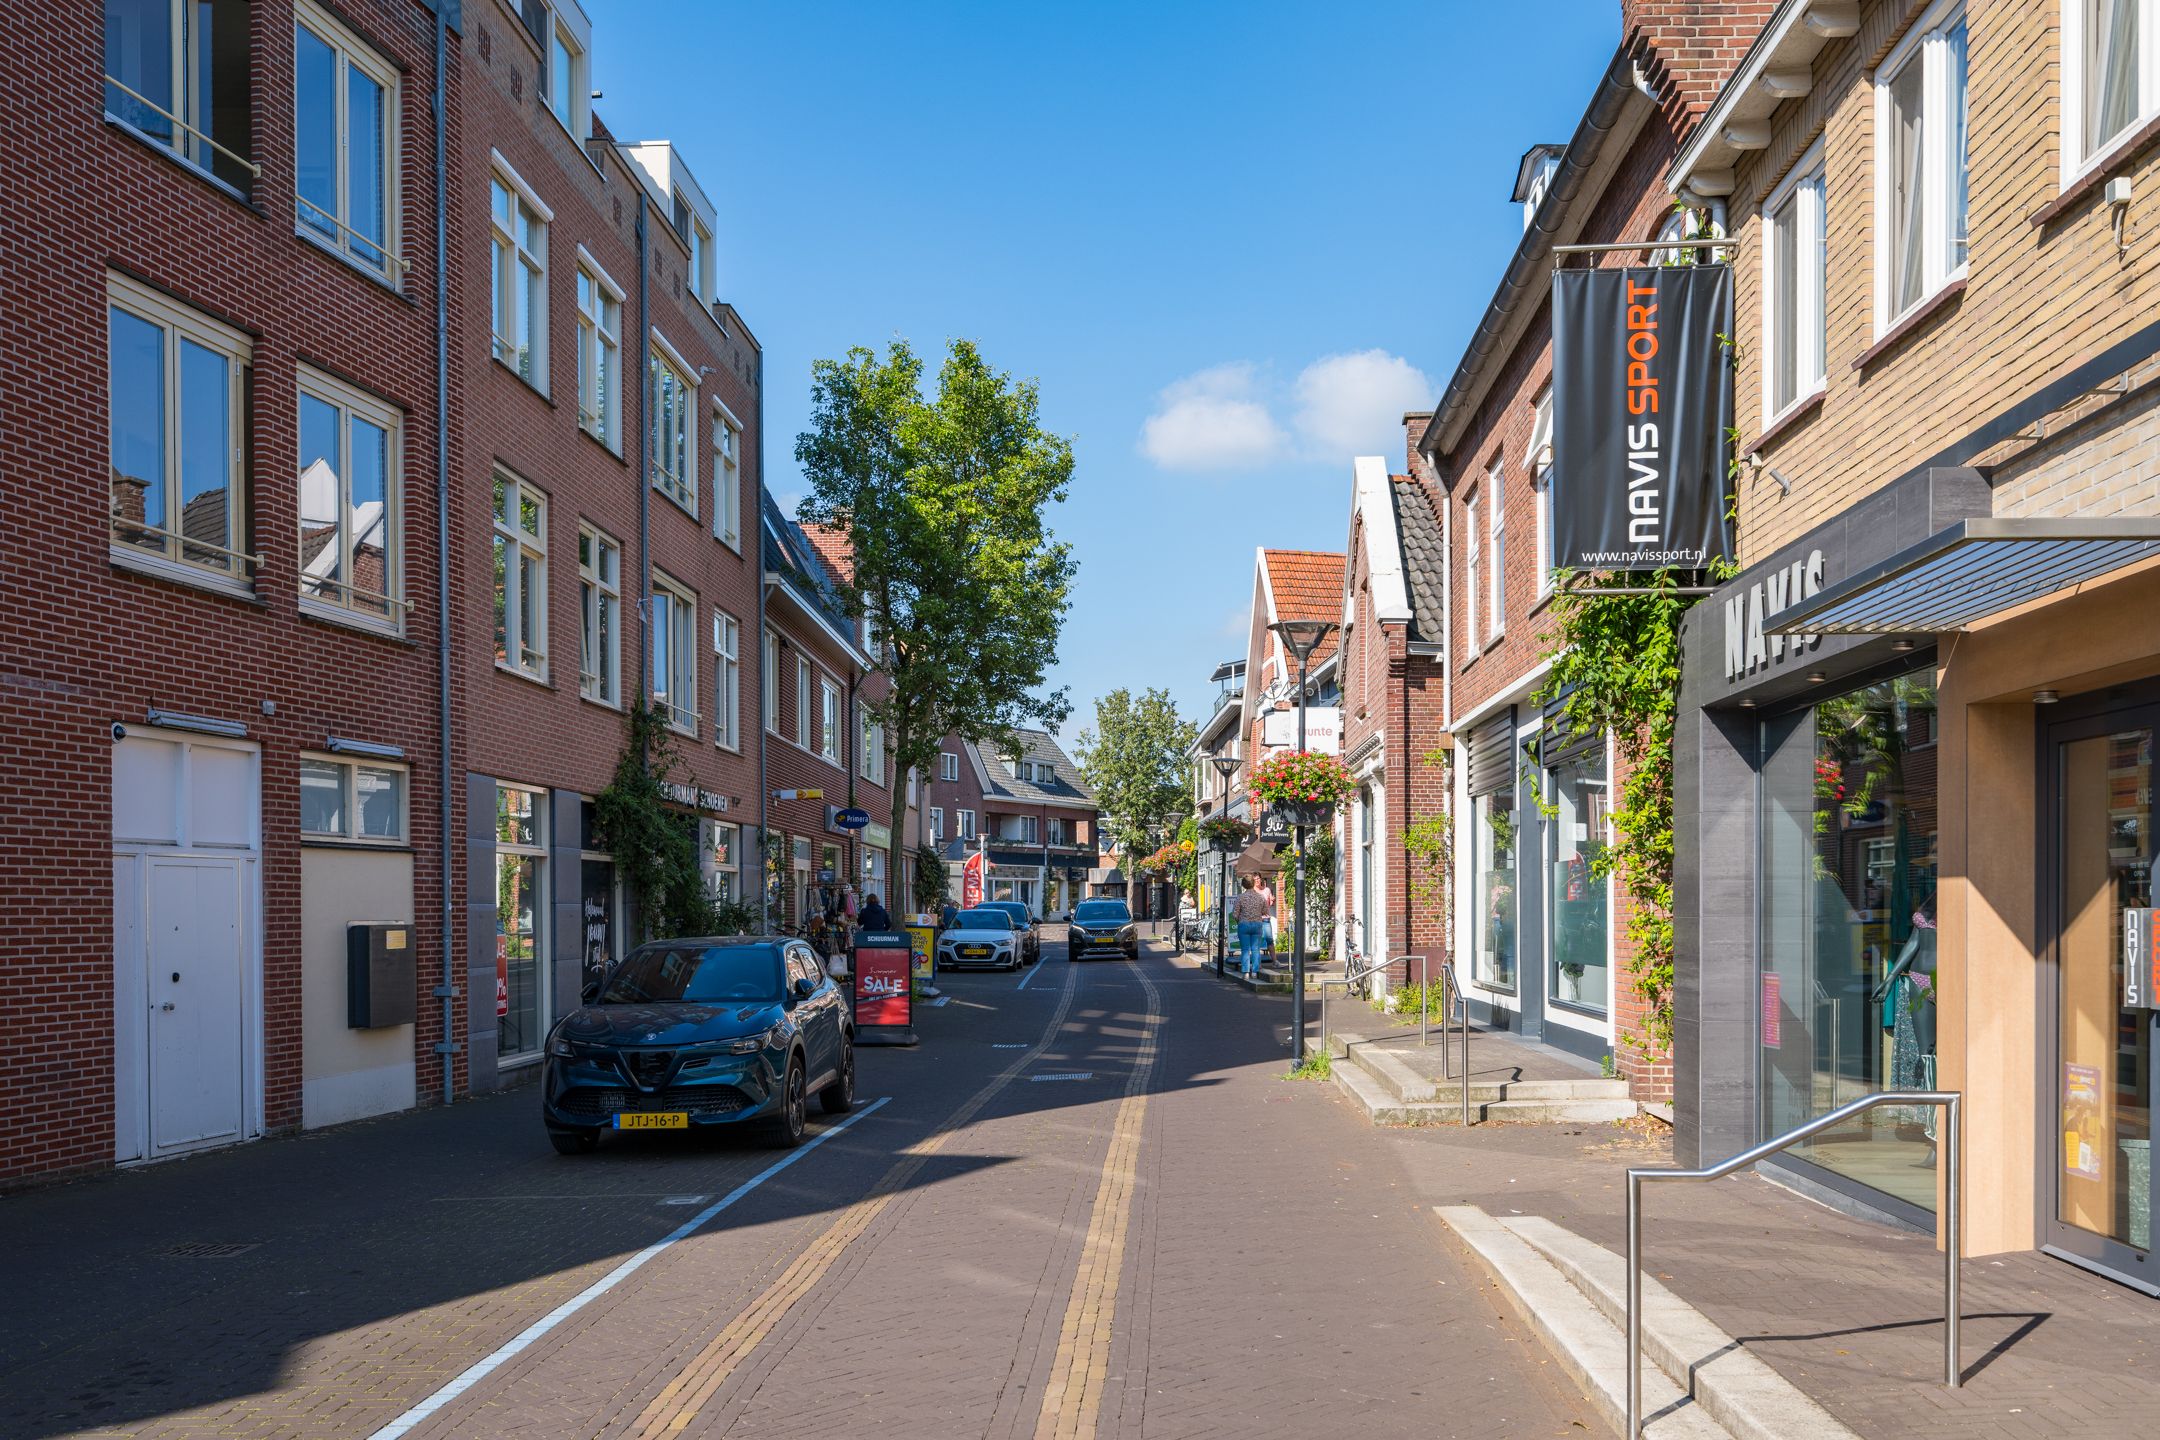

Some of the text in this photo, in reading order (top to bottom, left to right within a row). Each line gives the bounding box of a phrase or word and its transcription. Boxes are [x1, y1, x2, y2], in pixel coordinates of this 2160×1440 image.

[1627, 280, 1659, 543] NAVIS SPORT
[1582, 547, 1706, 564] www.navissport.nl
[1725, 550, 1823, 678] NAVIS
[846, 815, 869, 823] Primera
[967, 867, 979, 907] HEMA
[2127, 910, 2138, 1004] NAVIS
[869, 966, 897, 975] Summer
[864, 975, 903, 992] SALE
[628, 1115, 680, 1126] JTJ-16-P
